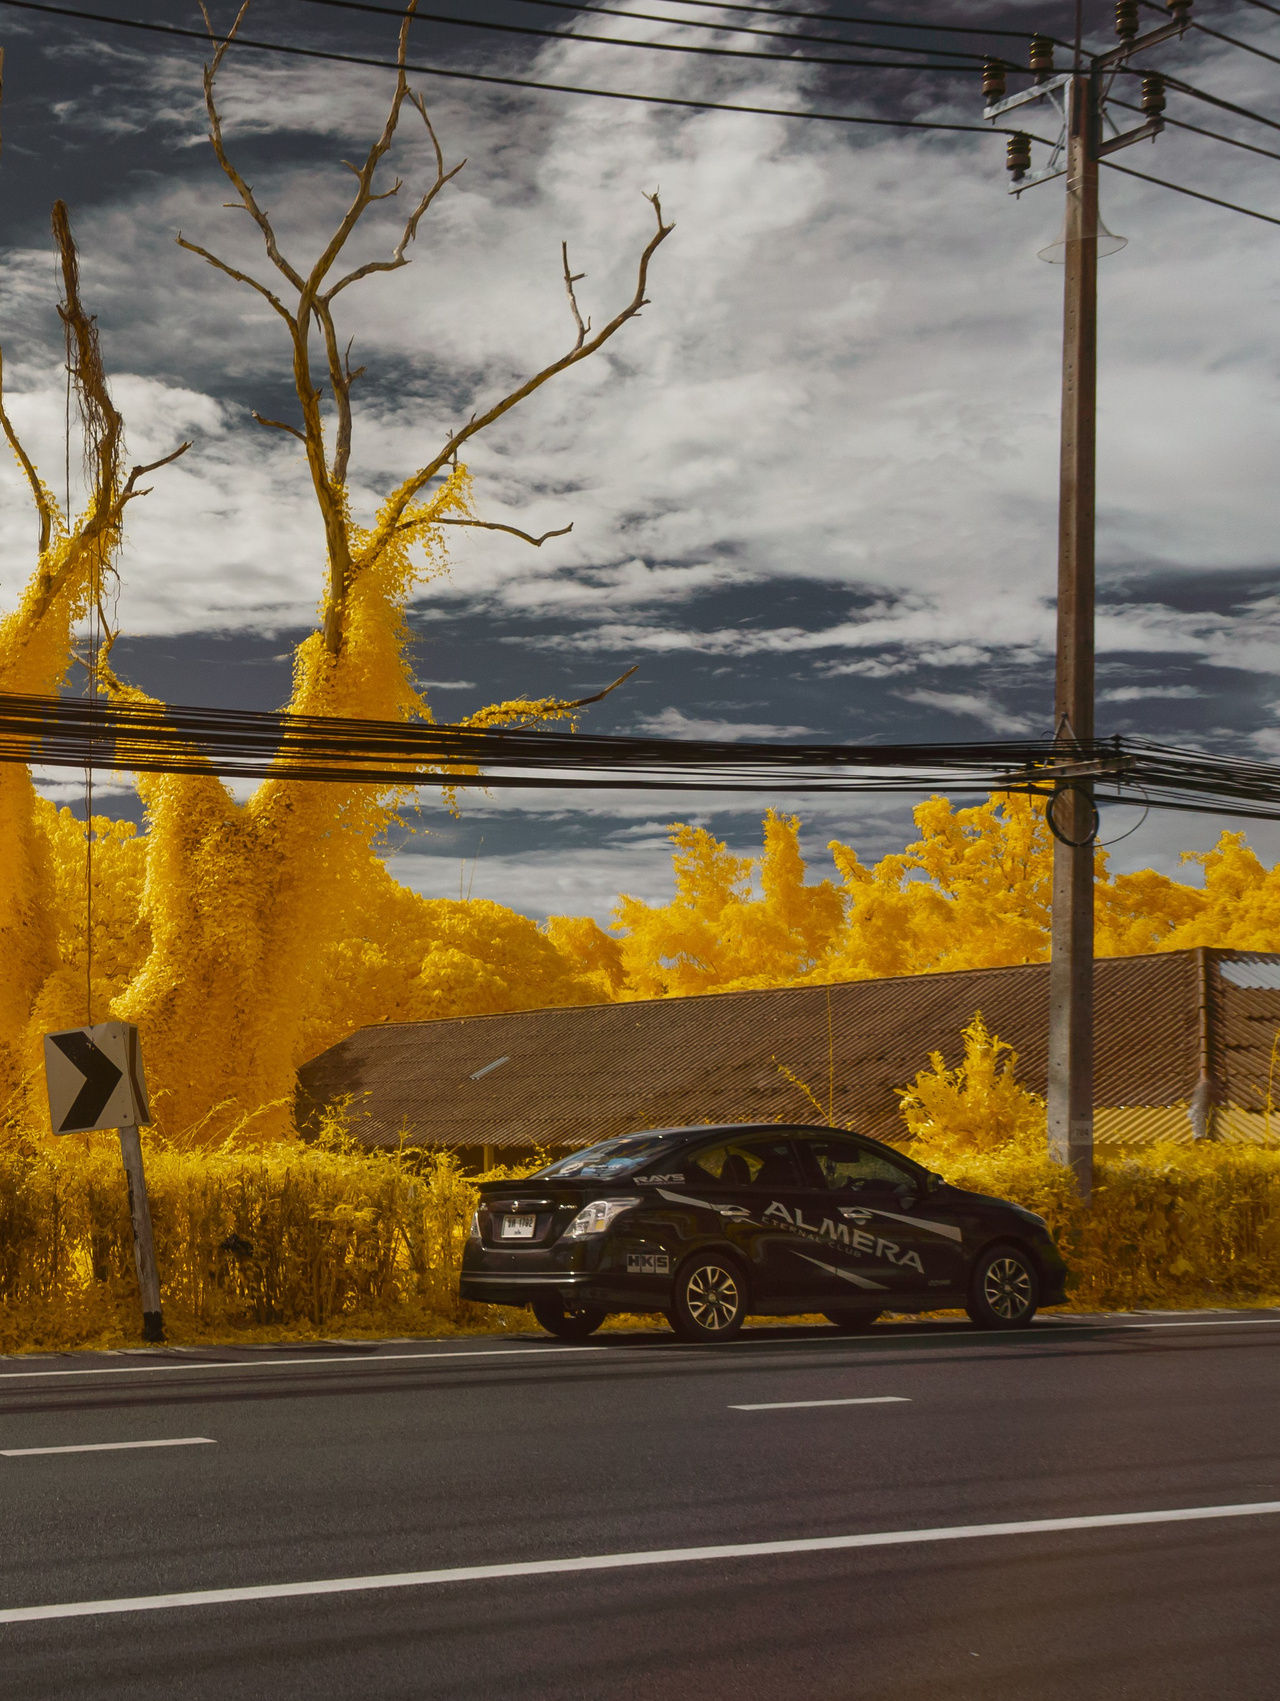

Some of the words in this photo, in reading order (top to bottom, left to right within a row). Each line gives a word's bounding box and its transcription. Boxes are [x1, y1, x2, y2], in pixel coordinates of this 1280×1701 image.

[632, 1173, 686, 1184] RAYS
[761, 1215, 824, 1244] ETERNAL
[827, 1241, 863, 1259] CLUB
[763, 1200, 926, 1275] ALMERA
[627, 1255, 668, 1268] HKS
